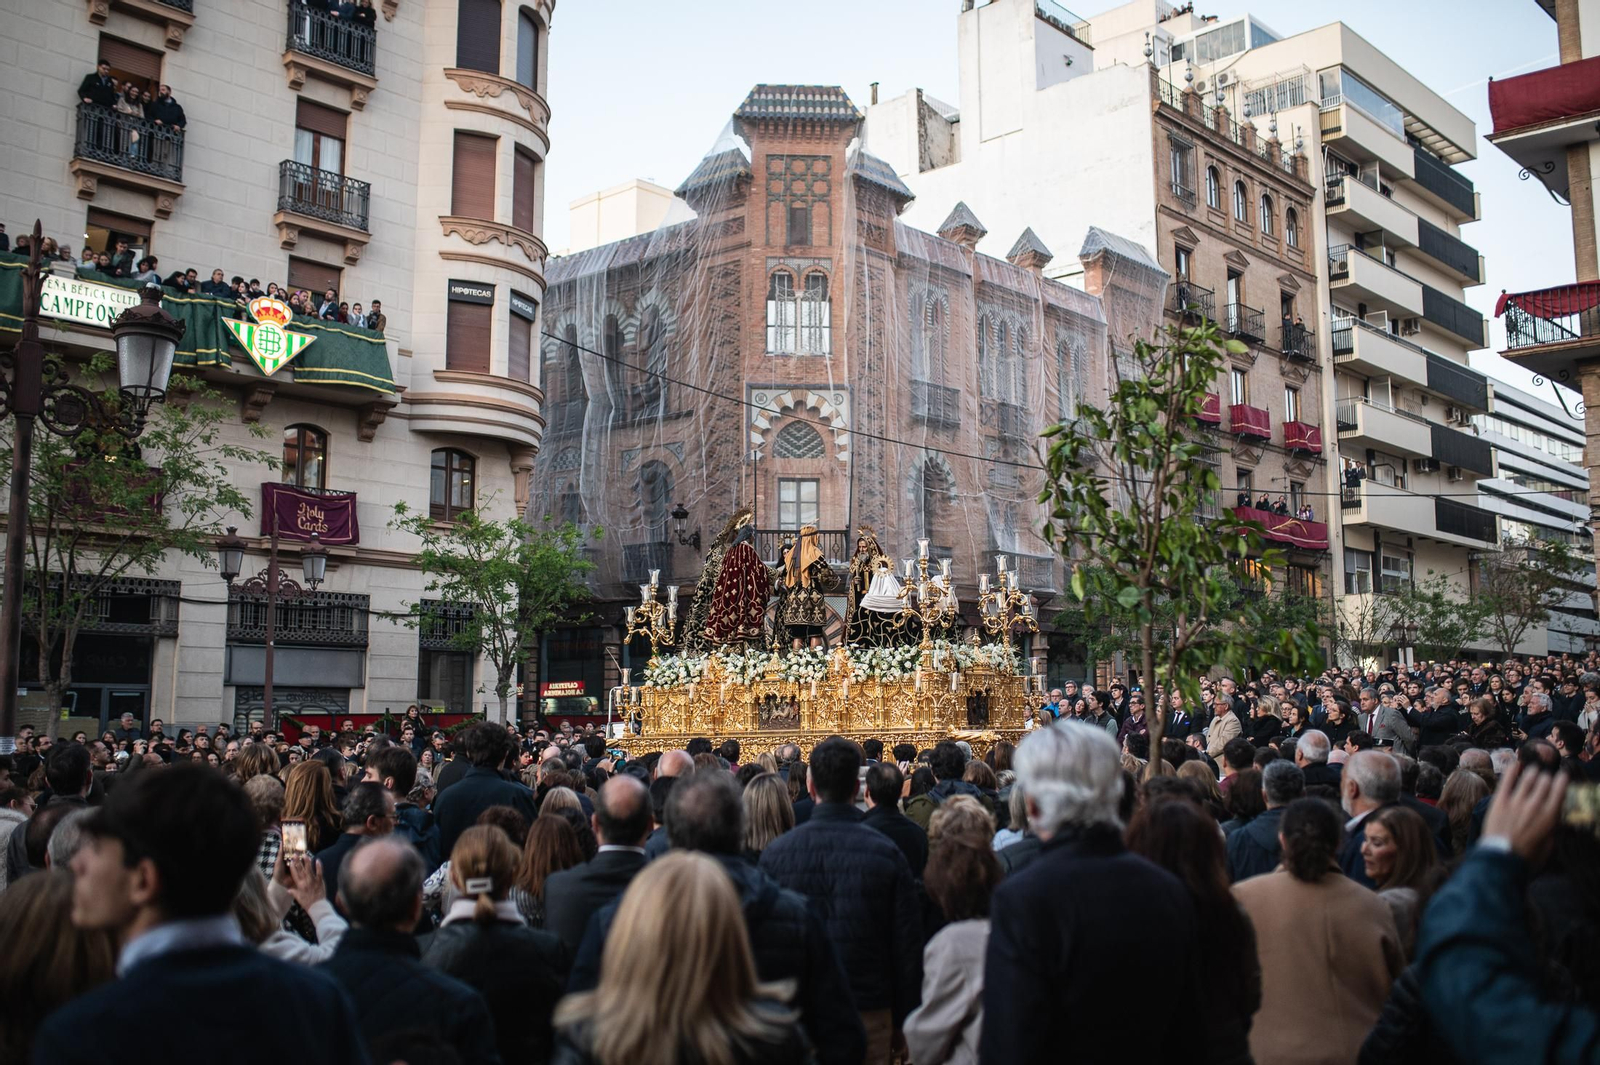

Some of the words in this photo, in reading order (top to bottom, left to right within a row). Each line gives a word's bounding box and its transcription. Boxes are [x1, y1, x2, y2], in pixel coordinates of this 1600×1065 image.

[45, 278, 67, 293] EÑA
[110, 292, 140, 306] CULTU
[451, 286, 492, 298] HIPOTECAS
[297, 502, 325, 521] Holy
[297, 516, 329, 533] Cards
